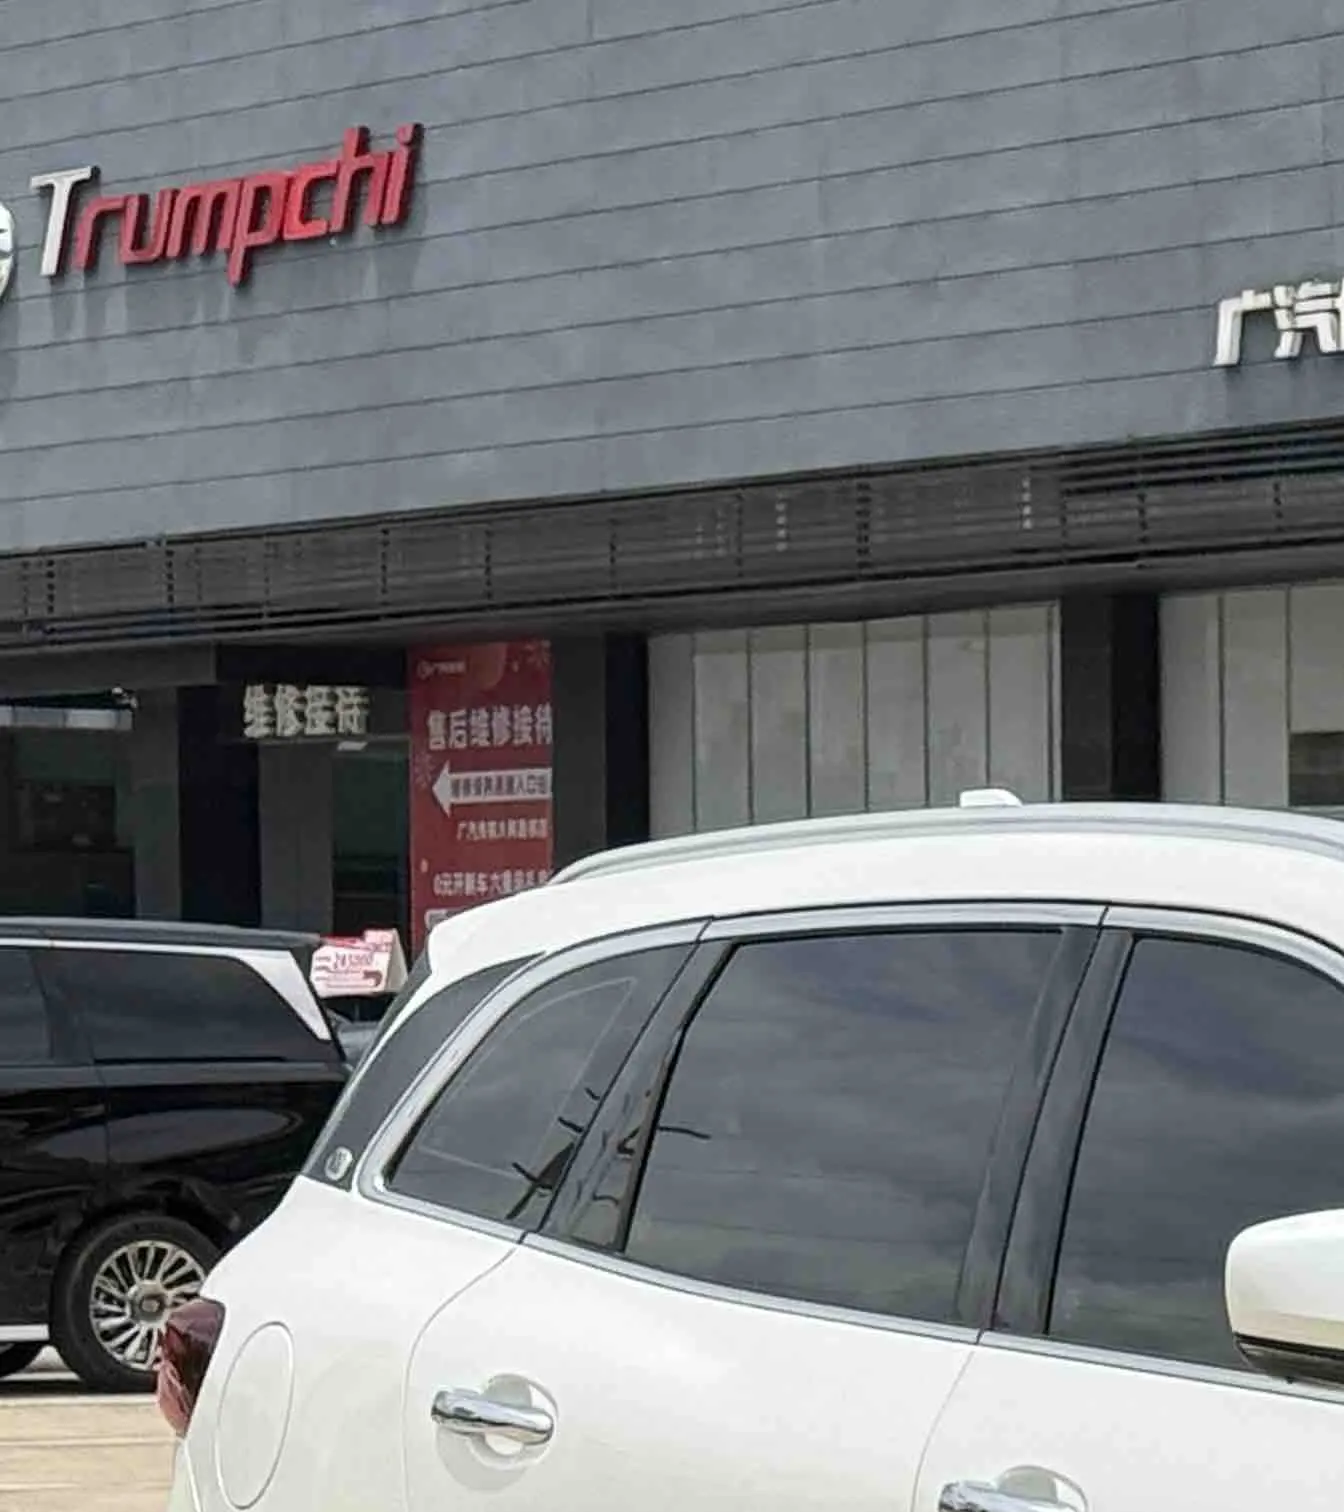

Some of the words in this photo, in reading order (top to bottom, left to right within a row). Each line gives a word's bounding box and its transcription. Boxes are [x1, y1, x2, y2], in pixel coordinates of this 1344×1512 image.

[30, 123, 423, 288] Trumpchi
[427, 702, 553, 750] 售后维修接待
